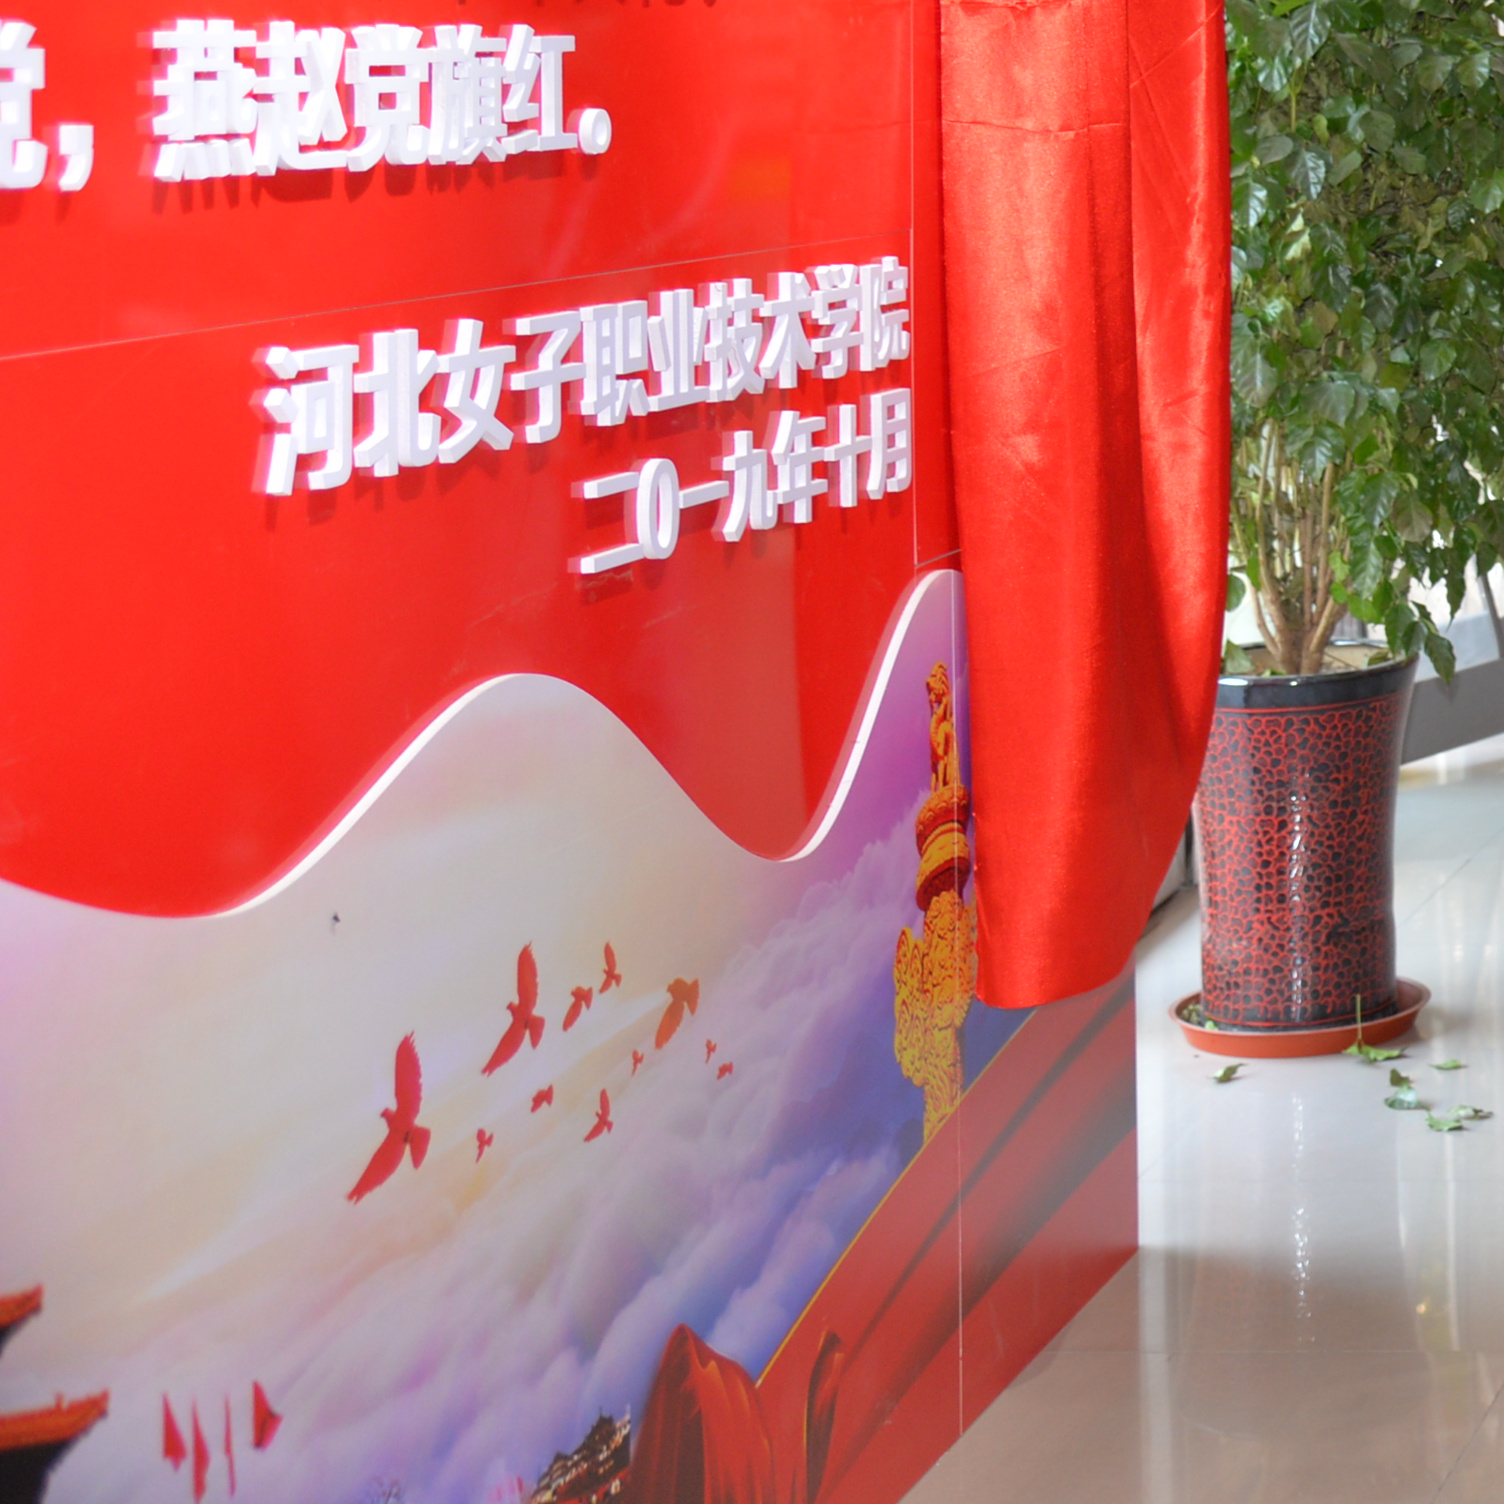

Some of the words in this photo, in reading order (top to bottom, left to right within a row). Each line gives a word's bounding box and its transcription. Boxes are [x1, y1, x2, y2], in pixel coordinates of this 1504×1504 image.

[257, 256, 911, 496] 河北女子职业技术学院
